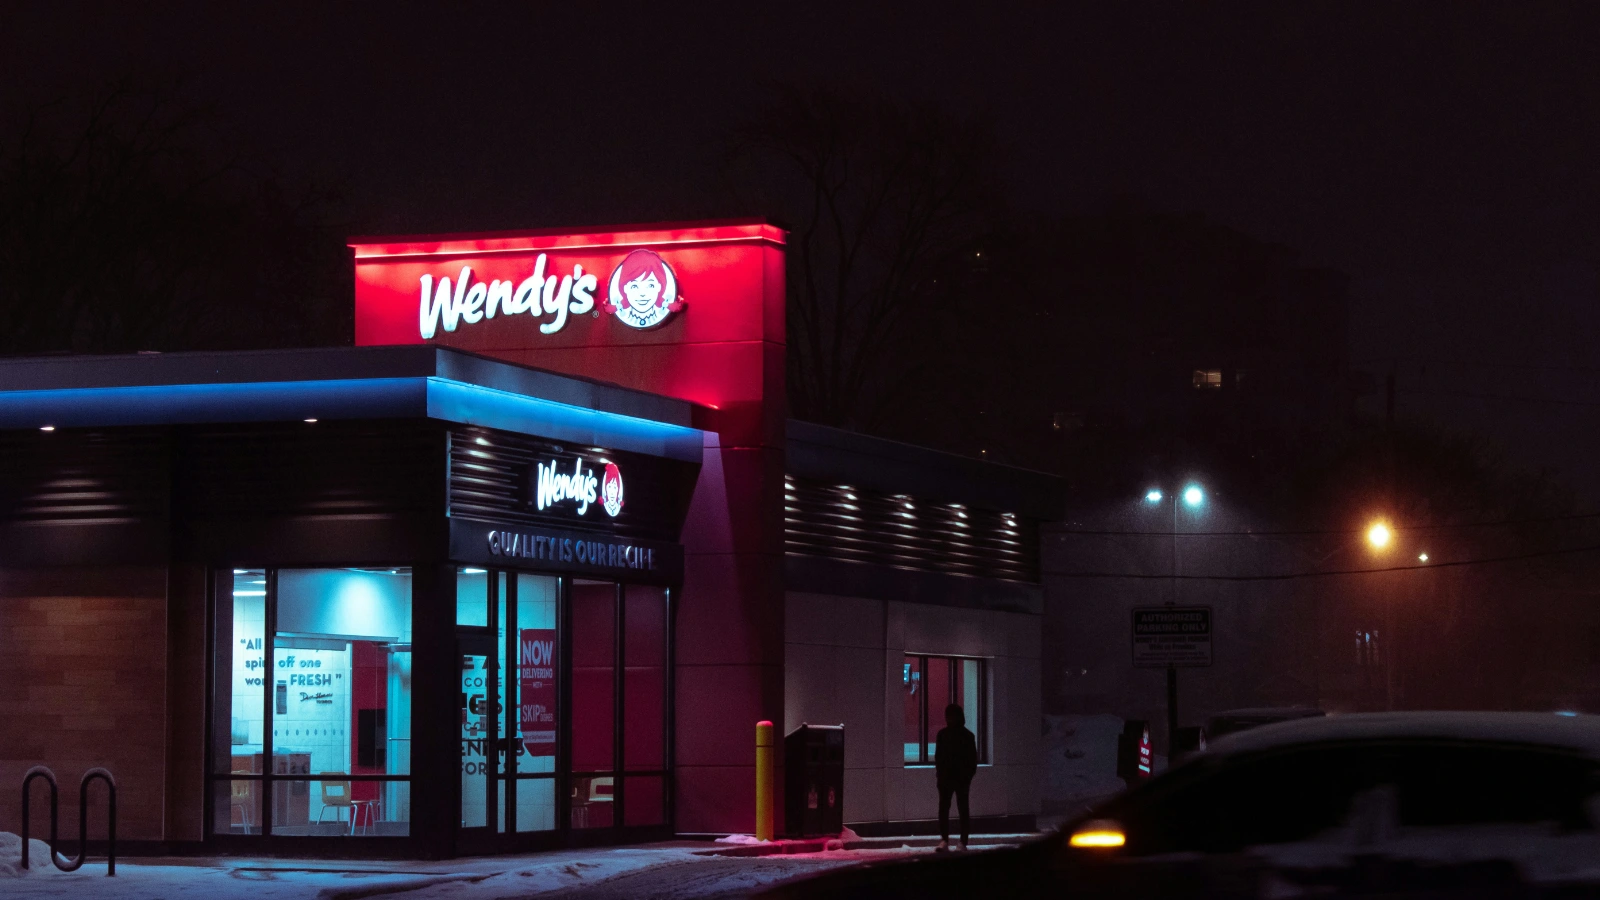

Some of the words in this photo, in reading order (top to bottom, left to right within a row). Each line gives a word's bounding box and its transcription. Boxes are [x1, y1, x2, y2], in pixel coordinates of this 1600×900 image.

[420, 253, 597, 339] Wendy's
[537, 457, 598, 515] Wendy's
[488, 530, 556, 561] QUALITY
[559, 538, 572, 562] IS
[575, 540, 608, 565] OUR
[608, 544, 656, 570] RECIPE
[1137, 623, 1179, 632] PARKING
[1182, 622, 1207, 632] ONLY
[1141, 613, 1203, 622] AUTHORIZED
[278, 655, 295, 668] off
[300, 659, 322, 668] one
[522, 640, 554, 666] NOW
[522, 667, 553, 679] DELIVERING
[522, 704, 540, 723] SKIP
